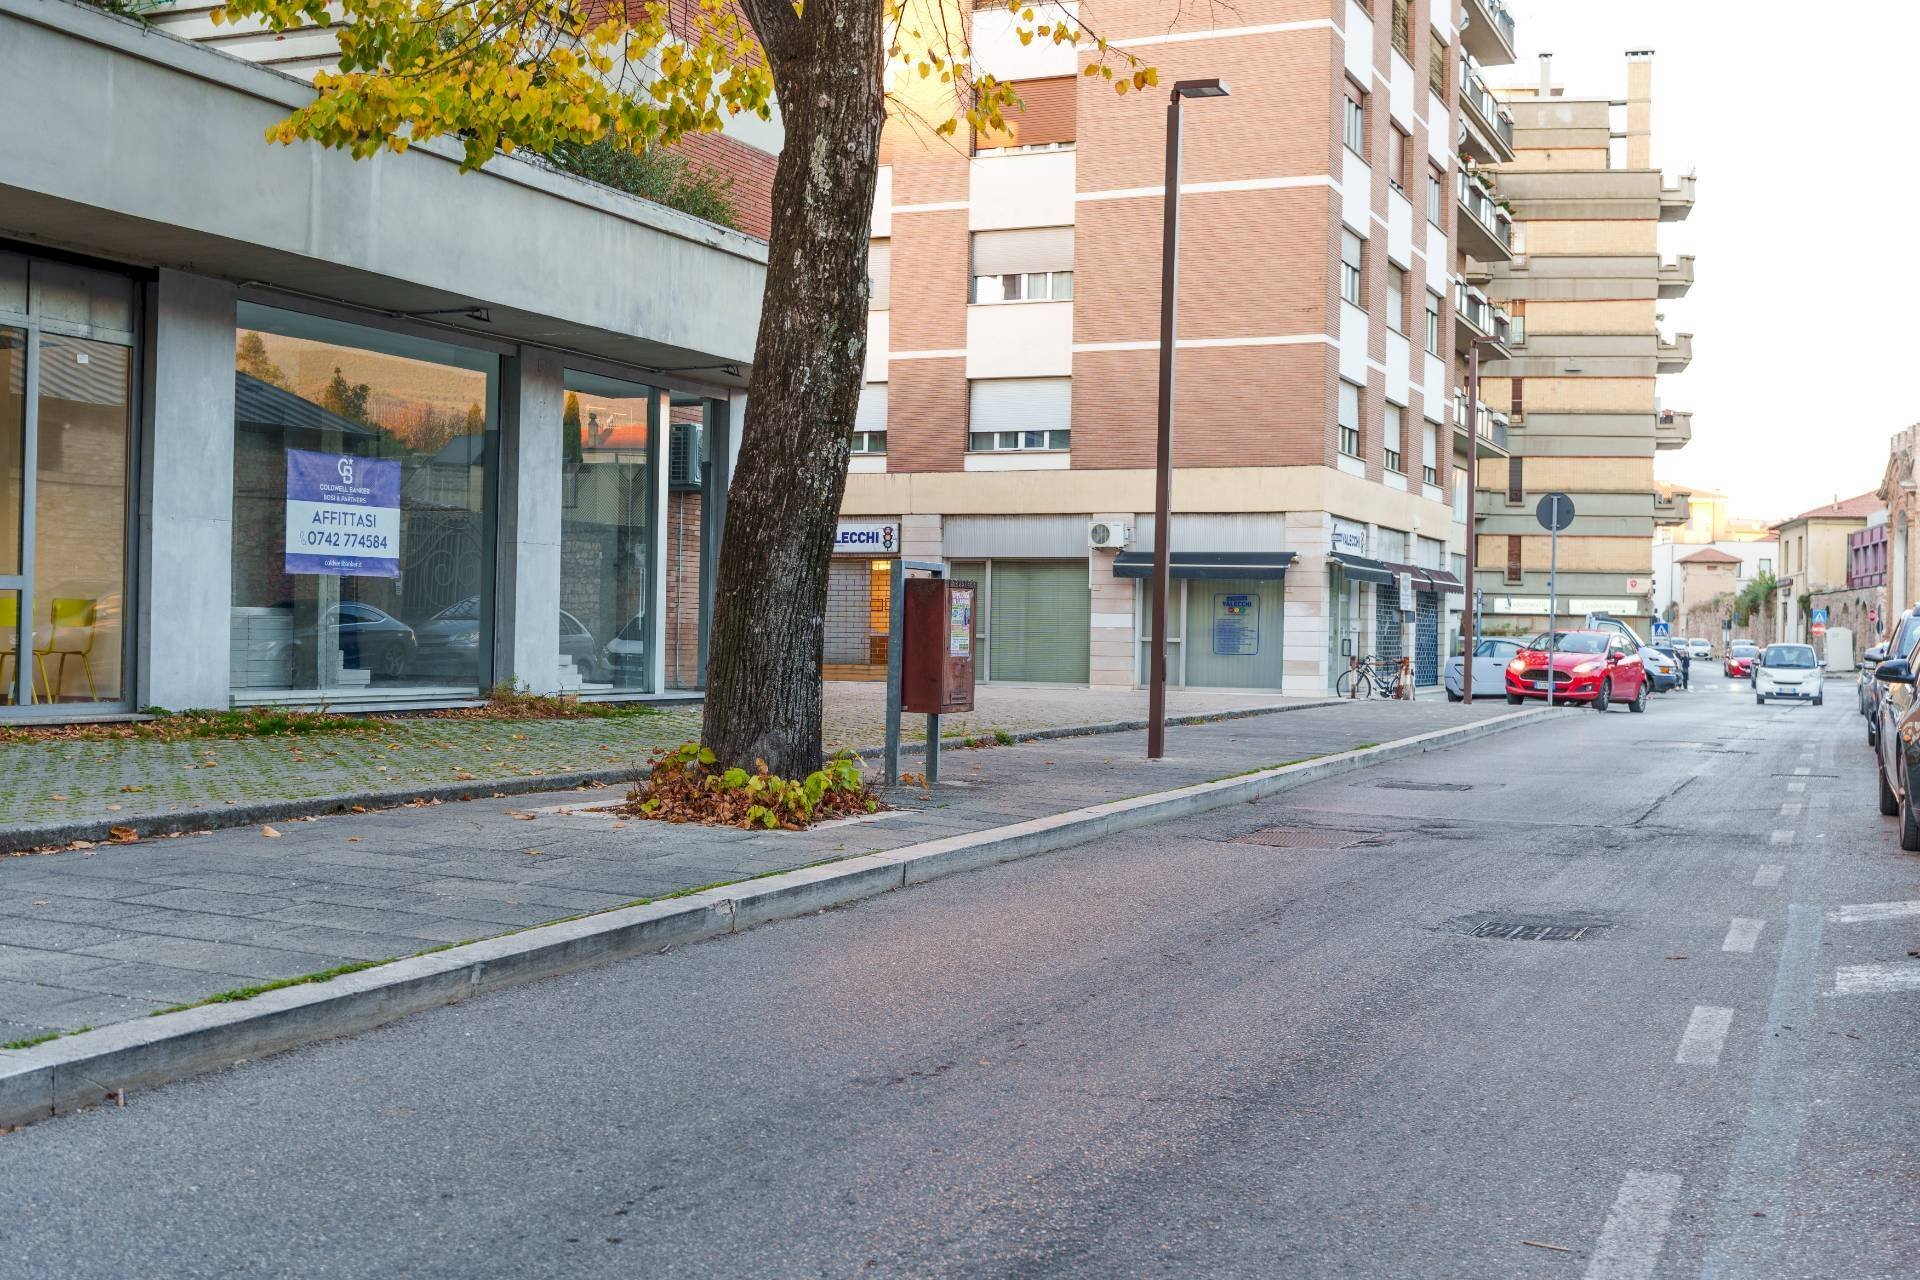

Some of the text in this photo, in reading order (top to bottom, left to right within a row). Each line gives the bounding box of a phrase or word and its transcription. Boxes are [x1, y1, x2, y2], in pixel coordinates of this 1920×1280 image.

[320, 484, 370, 495] COLDWELL BANKER
[312, 510, 377, 528] AFFITTASI
[307, 531, 388, 549] 0742 774584
